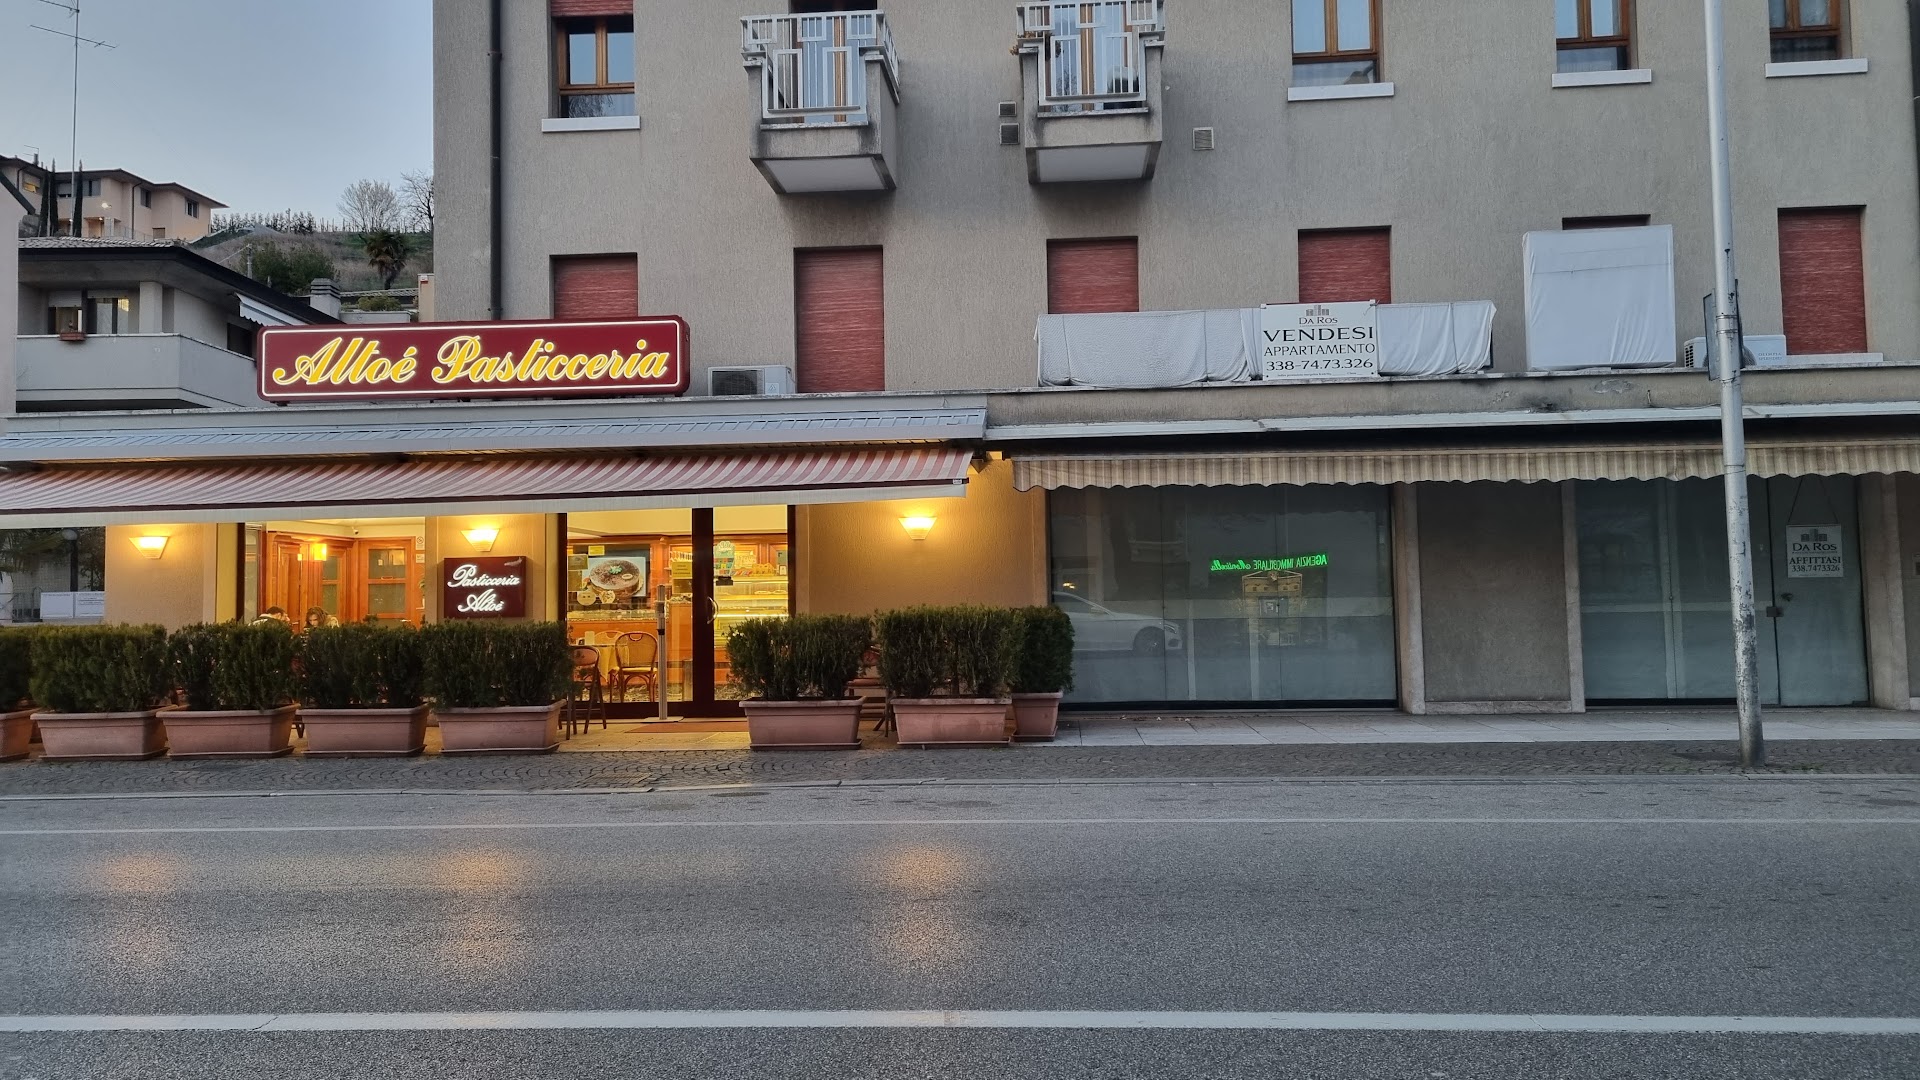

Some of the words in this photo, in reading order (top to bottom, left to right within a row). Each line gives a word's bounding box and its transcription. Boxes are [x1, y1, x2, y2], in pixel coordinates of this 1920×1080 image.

[1263, 326, 1373, 342] VENDESI
[1264, 343, 1376, 357] APPARTAMENTO
[431, 335, 669, 383] Pasticceria
[1266, 358, 1373, 372] 338-74.73.326
[1789, 556, 1841, 564] AFFITTASI
[447, 564, 521, 588] Pasticceria
